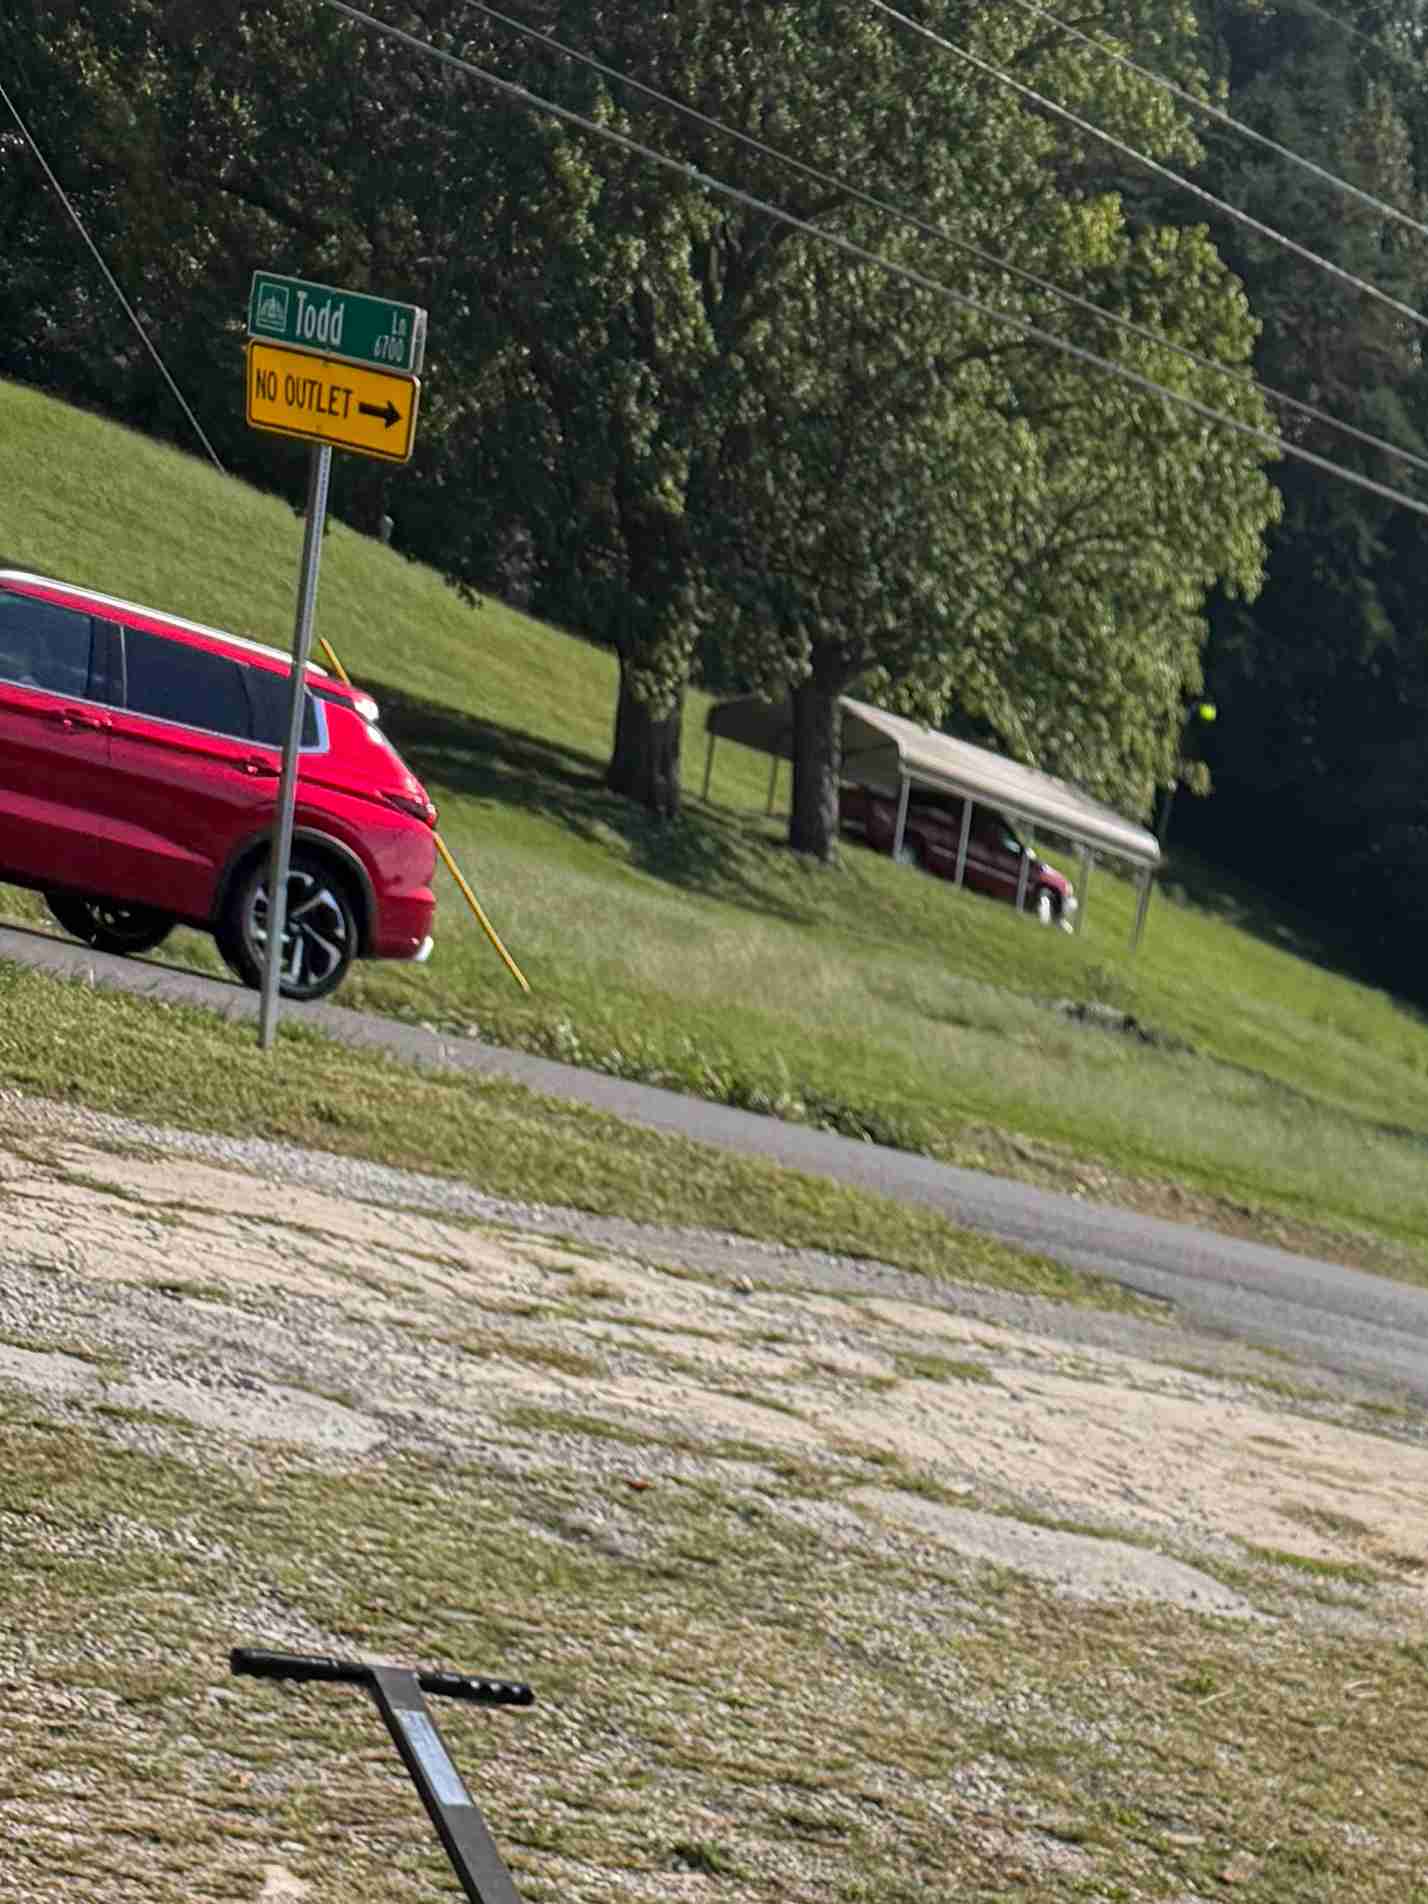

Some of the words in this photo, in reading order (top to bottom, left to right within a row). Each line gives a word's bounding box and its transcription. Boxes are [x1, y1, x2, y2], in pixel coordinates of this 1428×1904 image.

[296, 290, 344, 345] Todd
[255, 369, 277, 404] NO
[284, 376, 353, 419] OUTLET
